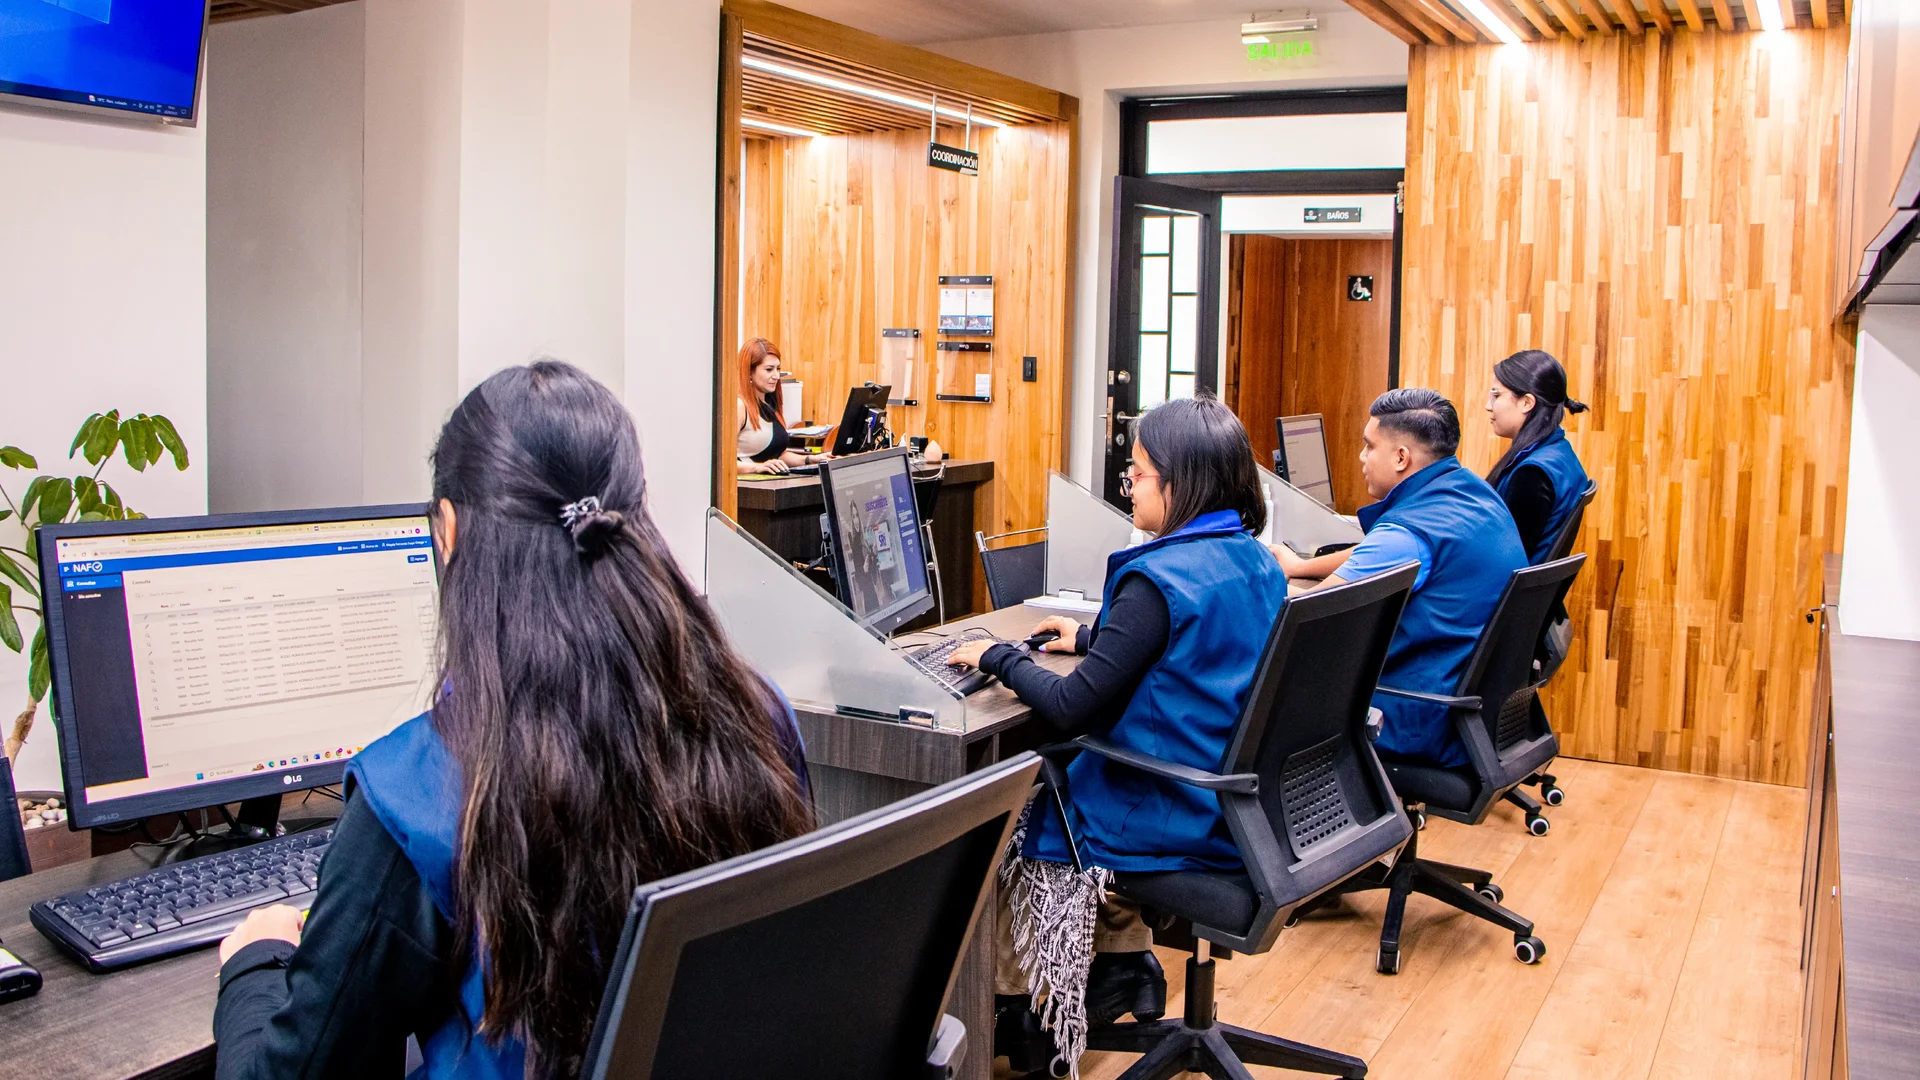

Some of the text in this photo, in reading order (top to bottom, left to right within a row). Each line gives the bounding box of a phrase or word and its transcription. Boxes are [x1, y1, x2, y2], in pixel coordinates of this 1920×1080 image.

[1247, 42, 1313, 60] SALIDA
[931, 149, 978, 169] COORDINACIÓN
[1326, 210, 1350, 220] BAÑOS
[292, 774, 302, 783] LG
